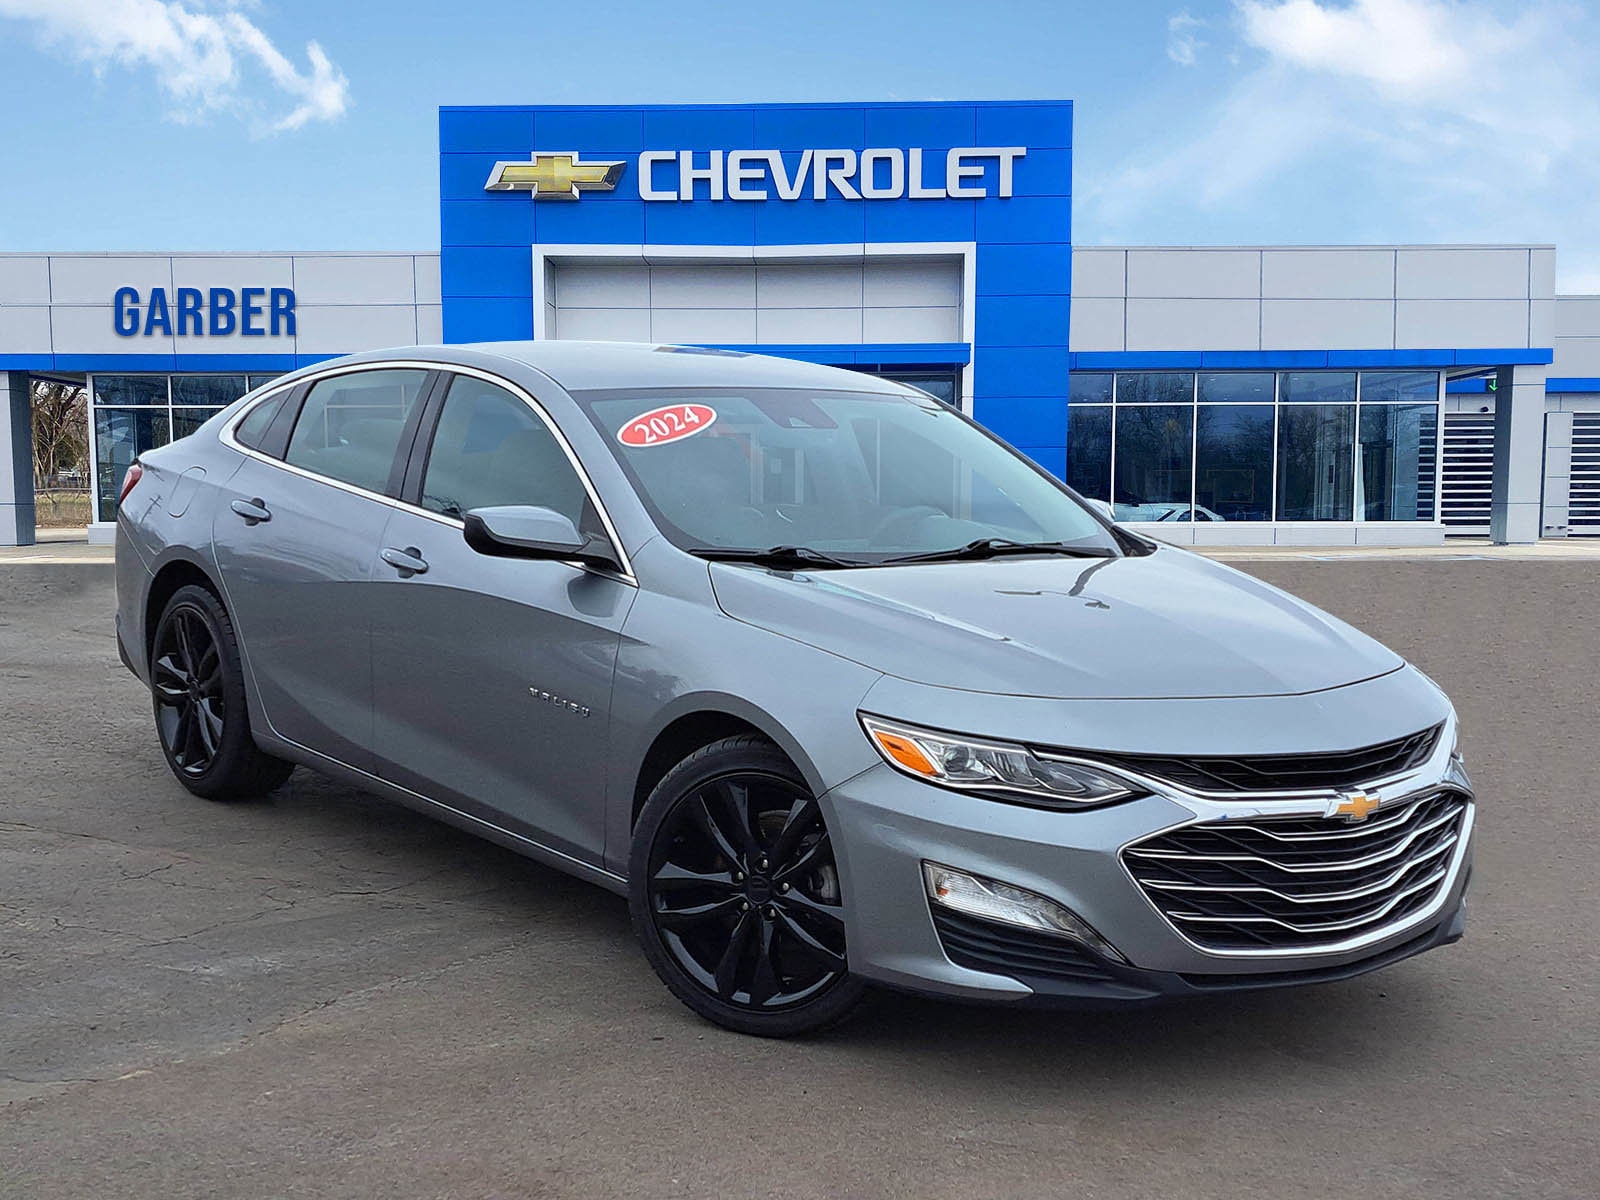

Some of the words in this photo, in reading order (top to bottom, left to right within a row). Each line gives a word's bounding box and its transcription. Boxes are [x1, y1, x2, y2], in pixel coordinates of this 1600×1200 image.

[638, 146, 1027, 202] CHEVROLET
[114, 286, 297, 337] GARBER
[634, 406, 700, 443] 2024
